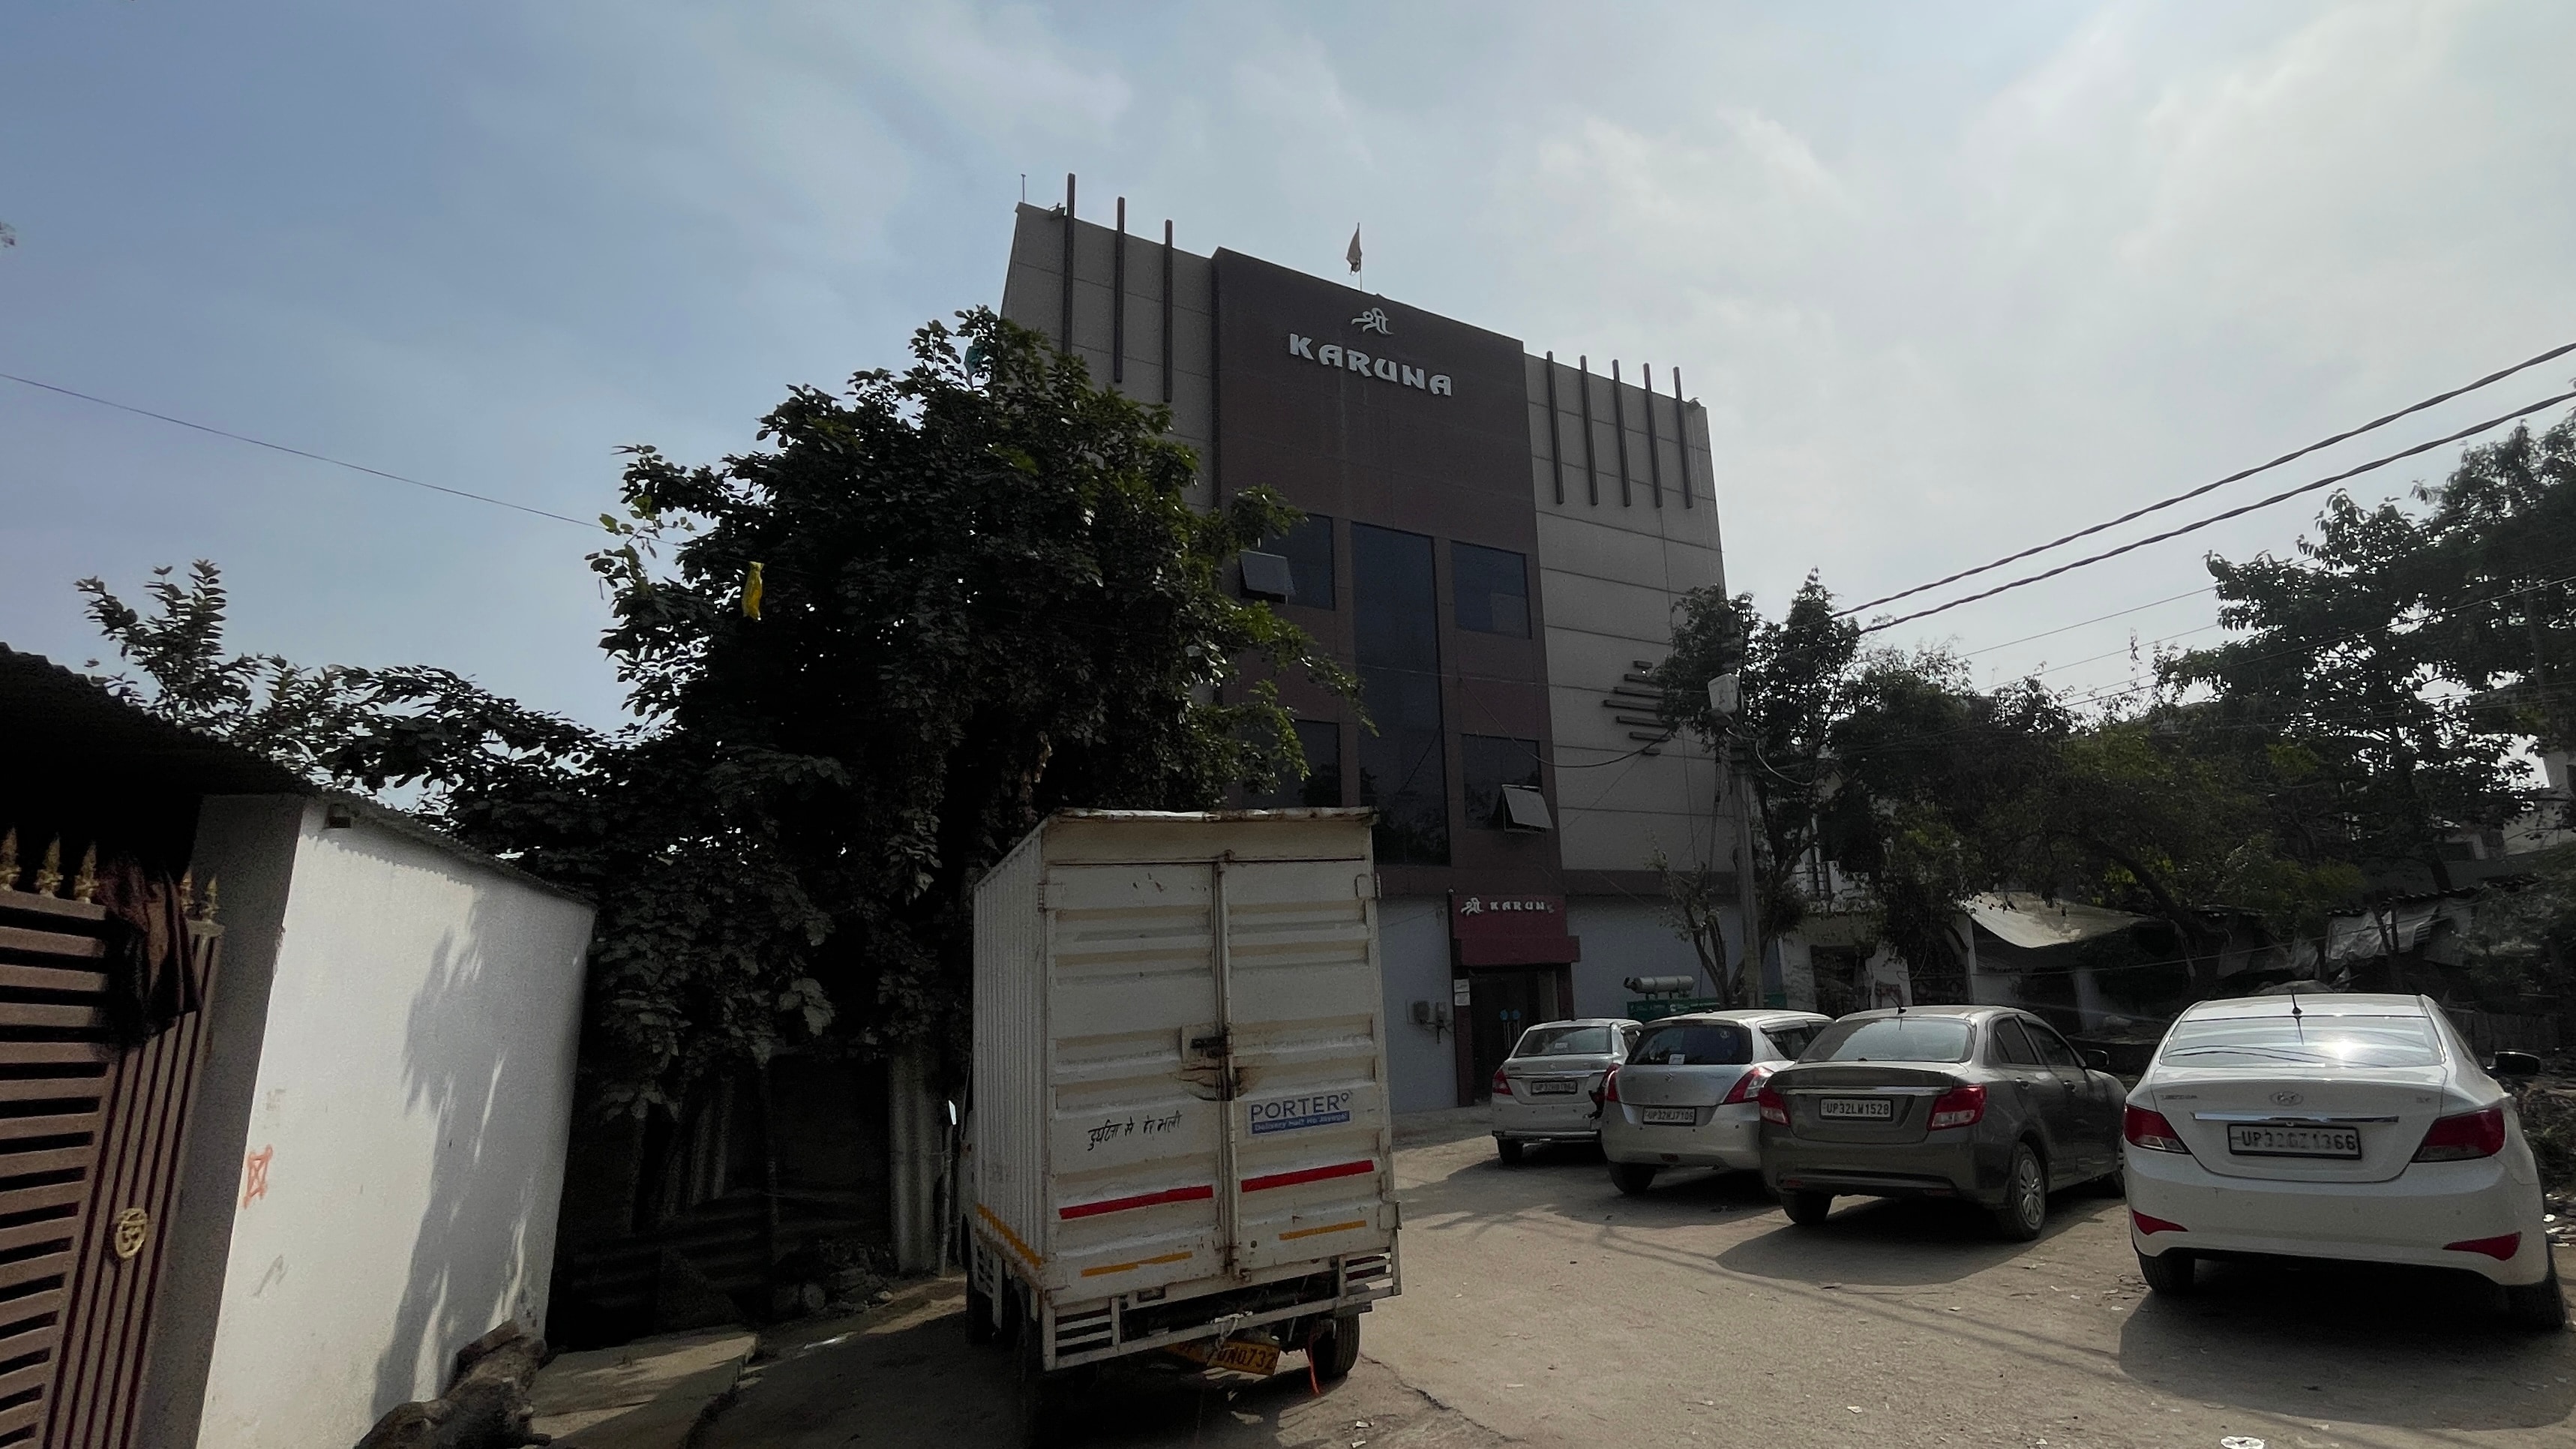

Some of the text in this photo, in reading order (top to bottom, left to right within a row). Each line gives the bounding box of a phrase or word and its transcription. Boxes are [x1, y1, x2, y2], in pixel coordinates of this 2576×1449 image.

[1351, 307, 1394, 335] श्री
[1288, 332, 1453, 397] KARUNA
[1460, 897, 1484, 916] श्री
[1250, 1094, 1340, 1122] PORTER
